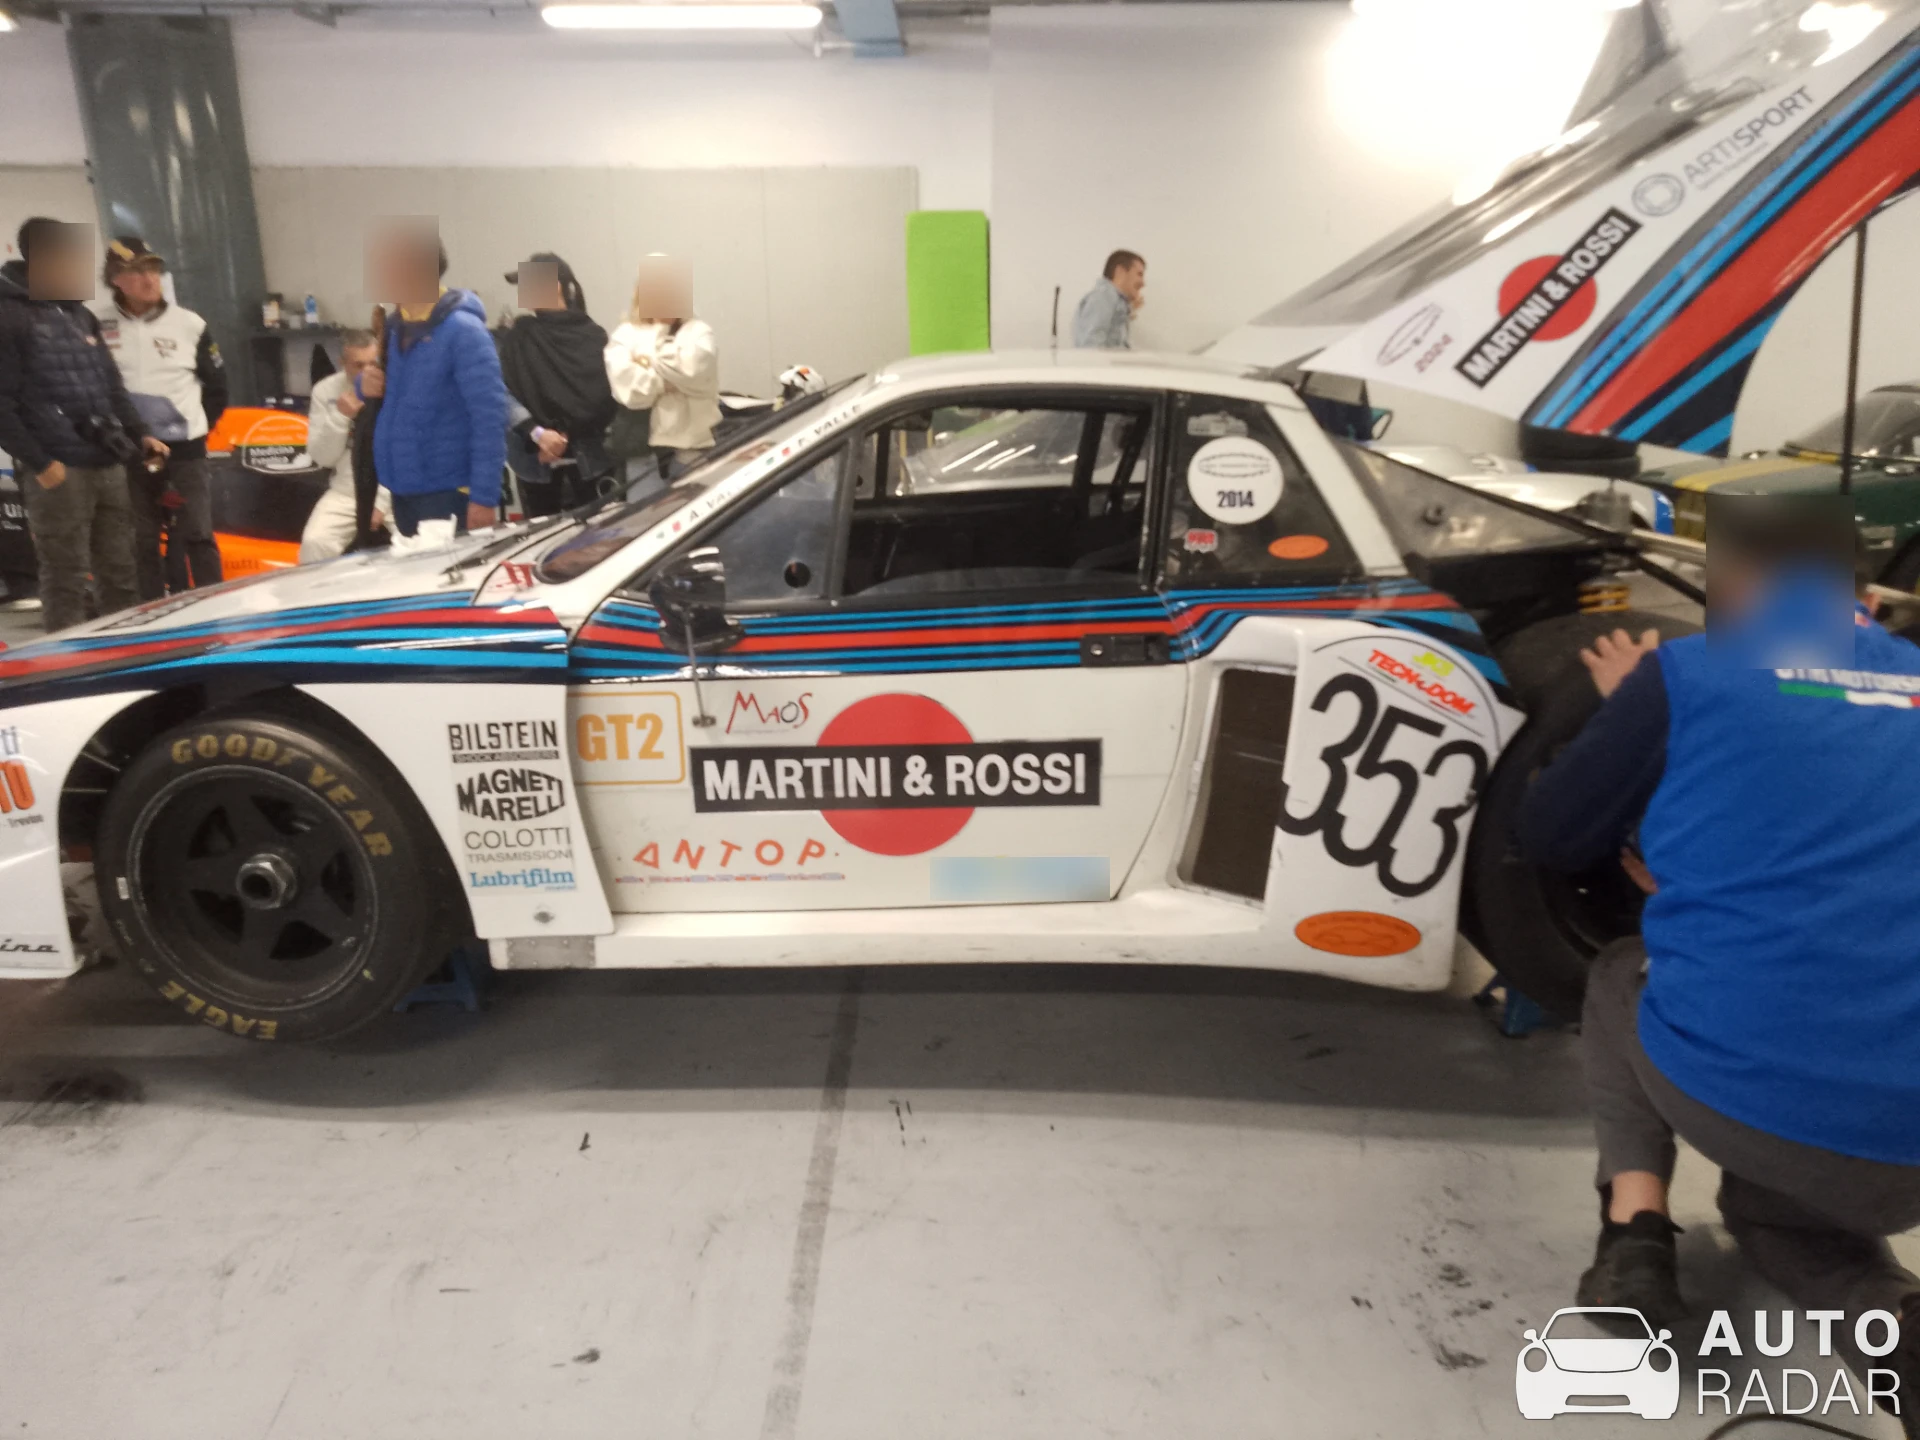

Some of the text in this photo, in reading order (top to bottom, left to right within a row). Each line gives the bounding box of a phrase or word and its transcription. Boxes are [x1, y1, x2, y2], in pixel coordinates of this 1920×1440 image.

[1684, 86, 1814, 184] ARTISPORT
[1462, 292, 1555, 381] MARTINI
[1542, 279, 1571, 301] &
[1557, 216, 1632, 285] ROSSI
[1415, 334, 1453, 373] 2024
[1217, 490, 1254, 508] 2014
[448, 720, 559, 751] BILSTEIN
[577, 712, 664, 761] GT2
[170, 732, 393, 858] GOODYEAR
[702, 752, 1086, 801] MARTINI & ROSSI
[1277, 673, 1488, 897] 353
[464, 827, 571, 850] COLOTTI
[467, 849, 573, 864] TRASMISSIONI
[632, 838, 827, 870] ANTOP
[470, 868, 575, 888] Lubrifilm
[158, 980, 278, 1040] EAGLE
